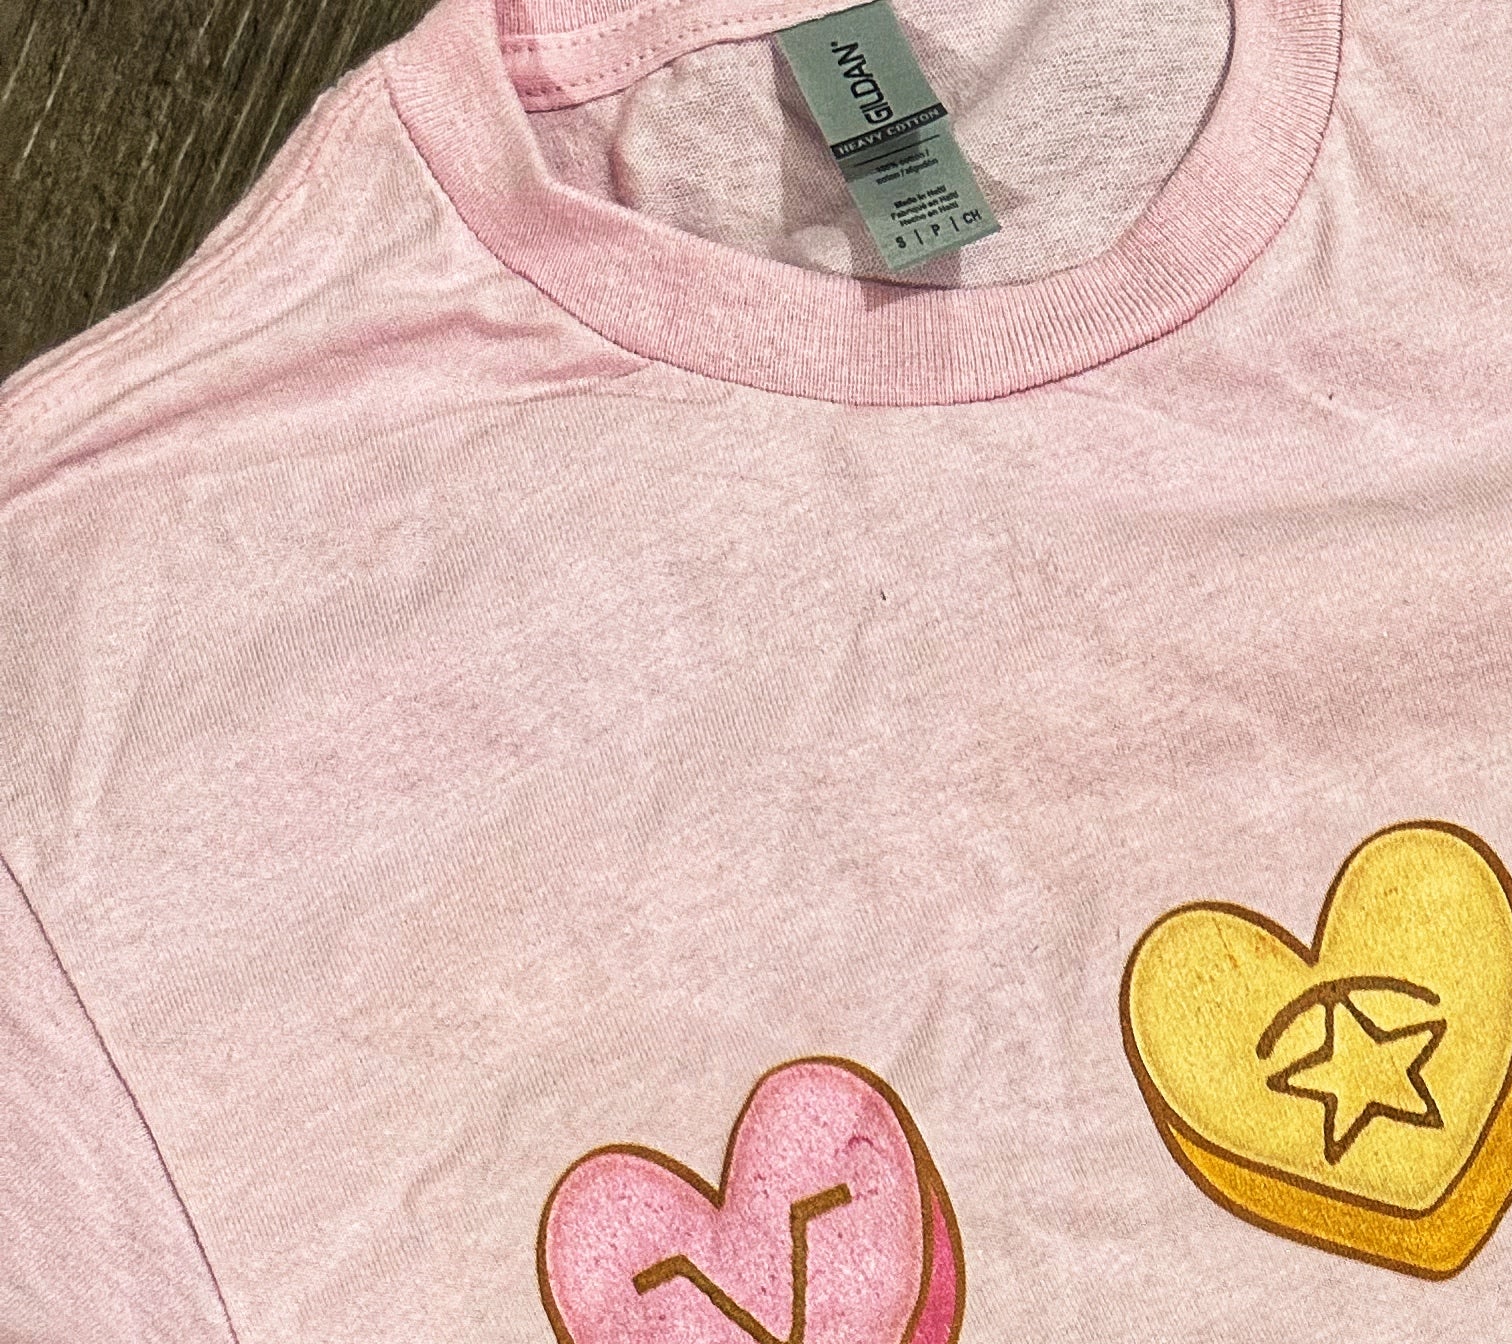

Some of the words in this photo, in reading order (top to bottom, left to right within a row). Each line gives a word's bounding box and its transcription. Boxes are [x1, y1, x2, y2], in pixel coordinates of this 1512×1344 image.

[831, 42, 894, 124] GILDAN
[839, 130, 883, 155] HEAVY
[886, 108, 940, 136] COTTON
[930, 223, 941, 237] P
[962, 208, 982, 225] CH
